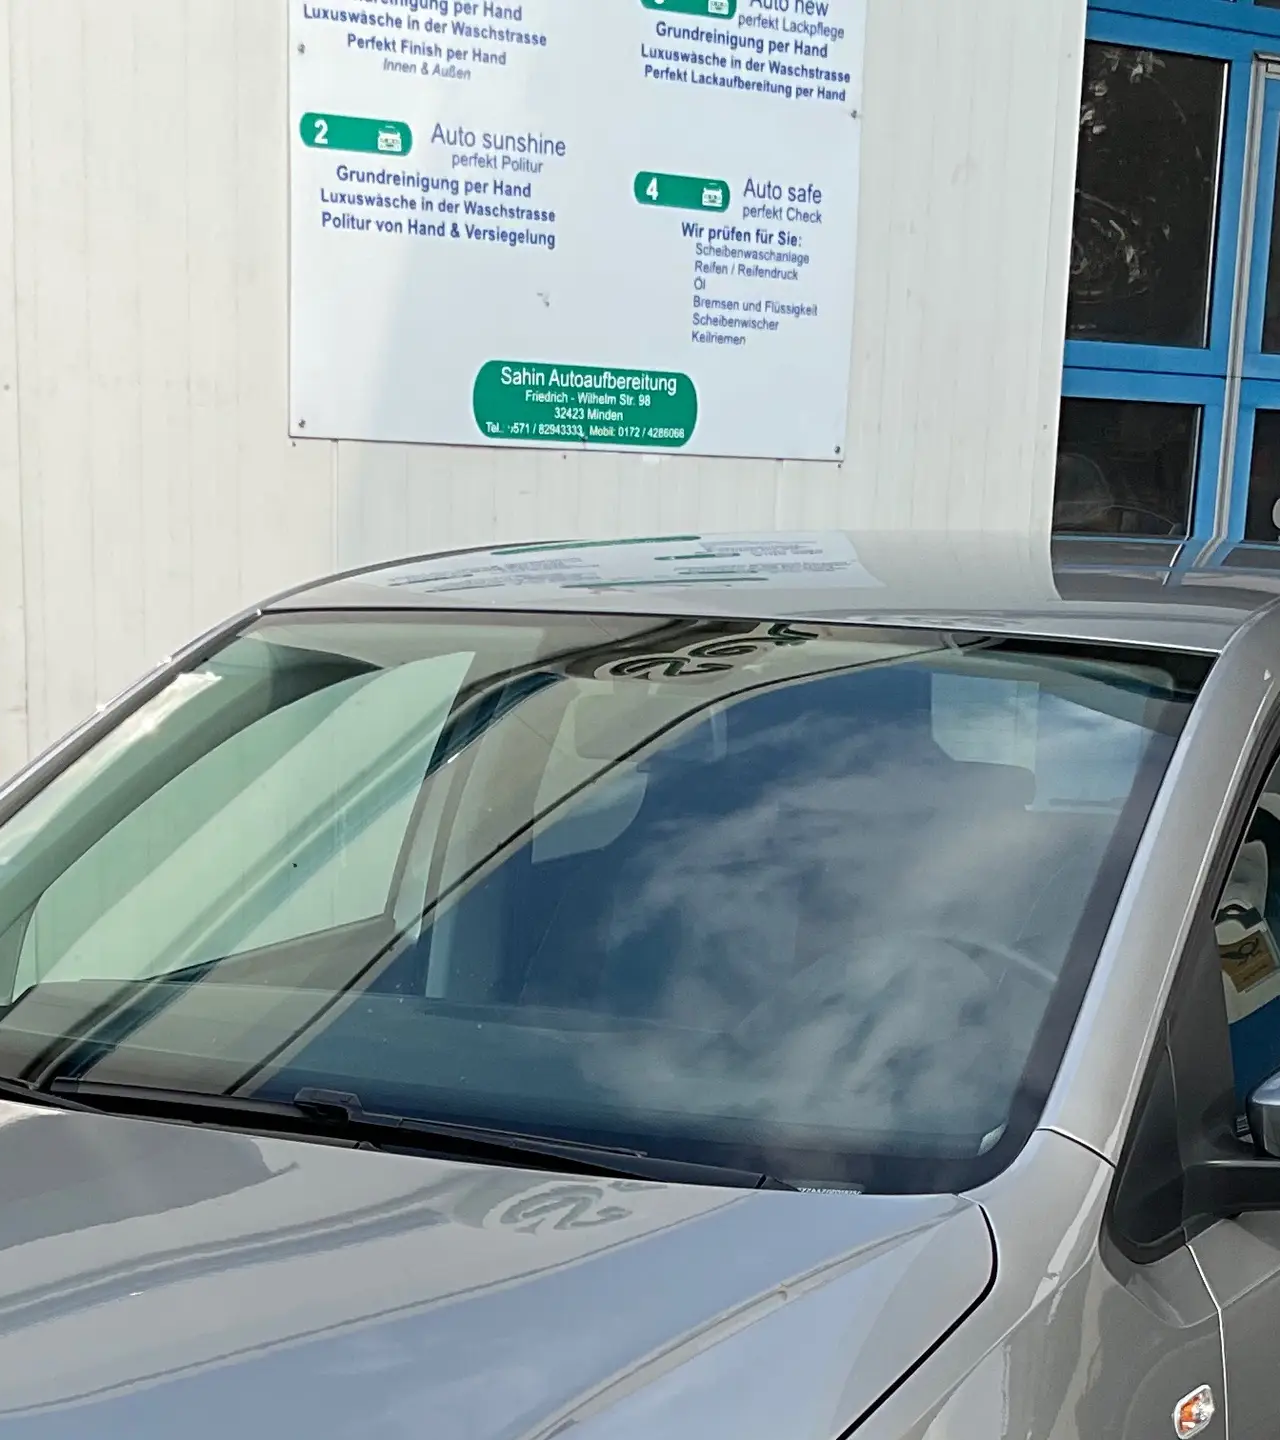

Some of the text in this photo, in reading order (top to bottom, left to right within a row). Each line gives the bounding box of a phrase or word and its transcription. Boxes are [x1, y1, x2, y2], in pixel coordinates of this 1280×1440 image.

[454, 0, 478, 17] per
[483, 4, 522, 21] Hand
[795, 1, 829, 17] new
[304, 4, 547, 46] Luxuswäsche in der Waschstrasse
[738, 14, 844, 42] perfekt Lackpflege
[347, 33, 506, 65] Perfekt Finish per Hand
[656, 21, 828, 58] Grundreinigung per Hand
[383, 58, 471, 80] Innen & Außen
[641, 43, 851, 83] Luxuswäsche in der Waschstrasse
[645, 65, 846, 101] Perfekt Lackaufbereitung per Hand
[314, 120, 328, 144] 2
[431, 123, 566, 156] Auto sunshine
[452, 153, 543, 173] perfekt Politur
[336, 165, 531, 198] Grundreinigung per Hand
[646, 177, 659, 200] 4
[744, 178, 822, 204] Auto safe
[321, 188, 555, 222] Luxuswäsche in der Waschstrasse
[742, 205, 822, 224] perfekt Check
[322, 212, 555, 250] Politur von Hand & Versiegelung
[682, 222, 802, 247] Wir prüfen für Sie:
[696, 243, 810, 267] Scheibenwaschanlage
[695, 261, 728, 275] Reifen
[738, 264, 798, 280] Reifendruck
[694, 276, 705, 290] Öl
[693, 296, 818, 318] Bremsen und Flüssigkeit
[693, 313, 779, 331] Scheibenwischer
[692, 330, 746, 346] Keilriemen
[501, 366, 677, 396] Sahin Autoaufbereitung
[525, 389, 568, 404] Friedrich
[578, 392, 616, 406] Wilhelm
[619, 393, 635, 406] Str.
[638, 395, 651, 407] 98
[554, 407, 623, 421] 32423 Minden
[618, 426, 639, 437] 0172
